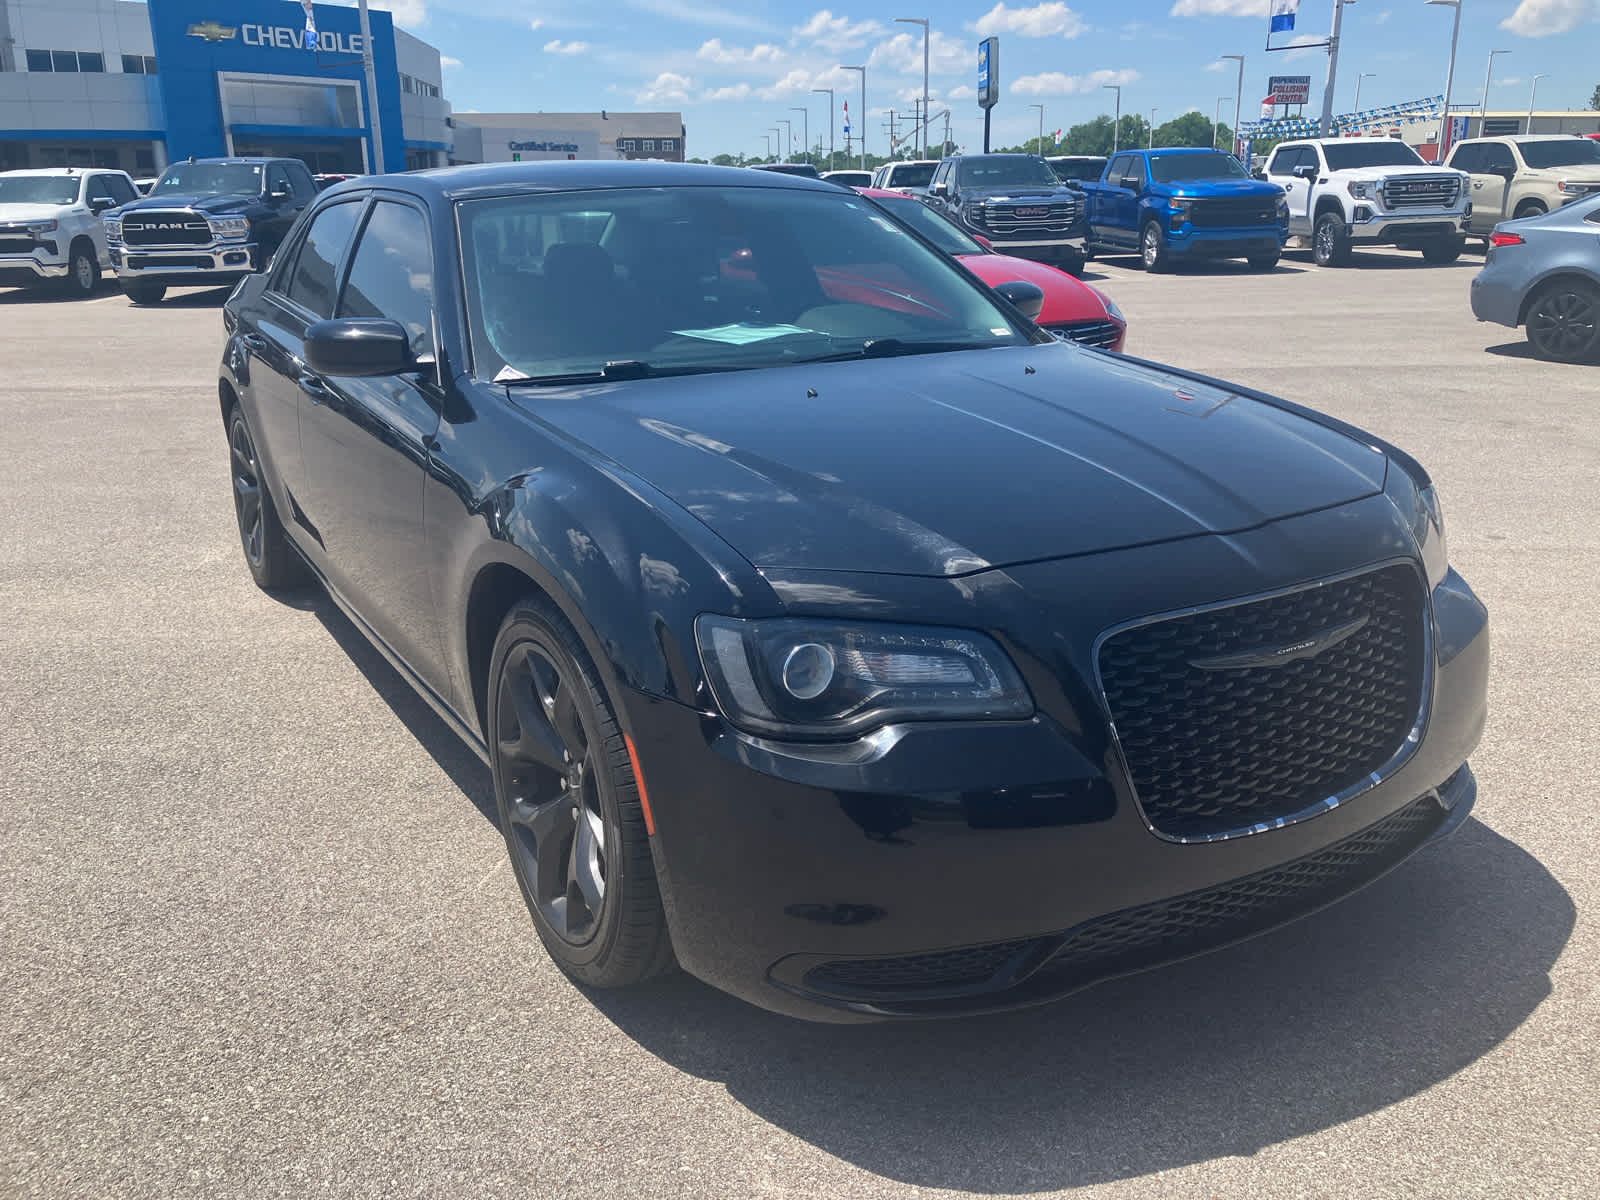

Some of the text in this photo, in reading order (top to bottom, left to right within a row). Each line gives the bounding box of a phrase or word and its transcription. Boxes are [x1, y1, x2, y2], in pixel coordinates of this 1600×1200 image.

[1272, 85, 1308, 94] COLLISION
[1275, 94, 1304, 103] CENTER
[508, 140, 578, 152] Certified Service
[1407, 183, 1440, 192] GMC
[1015, 207, 1048, 216] GMC
[144, 222, 183, 231] RAM
